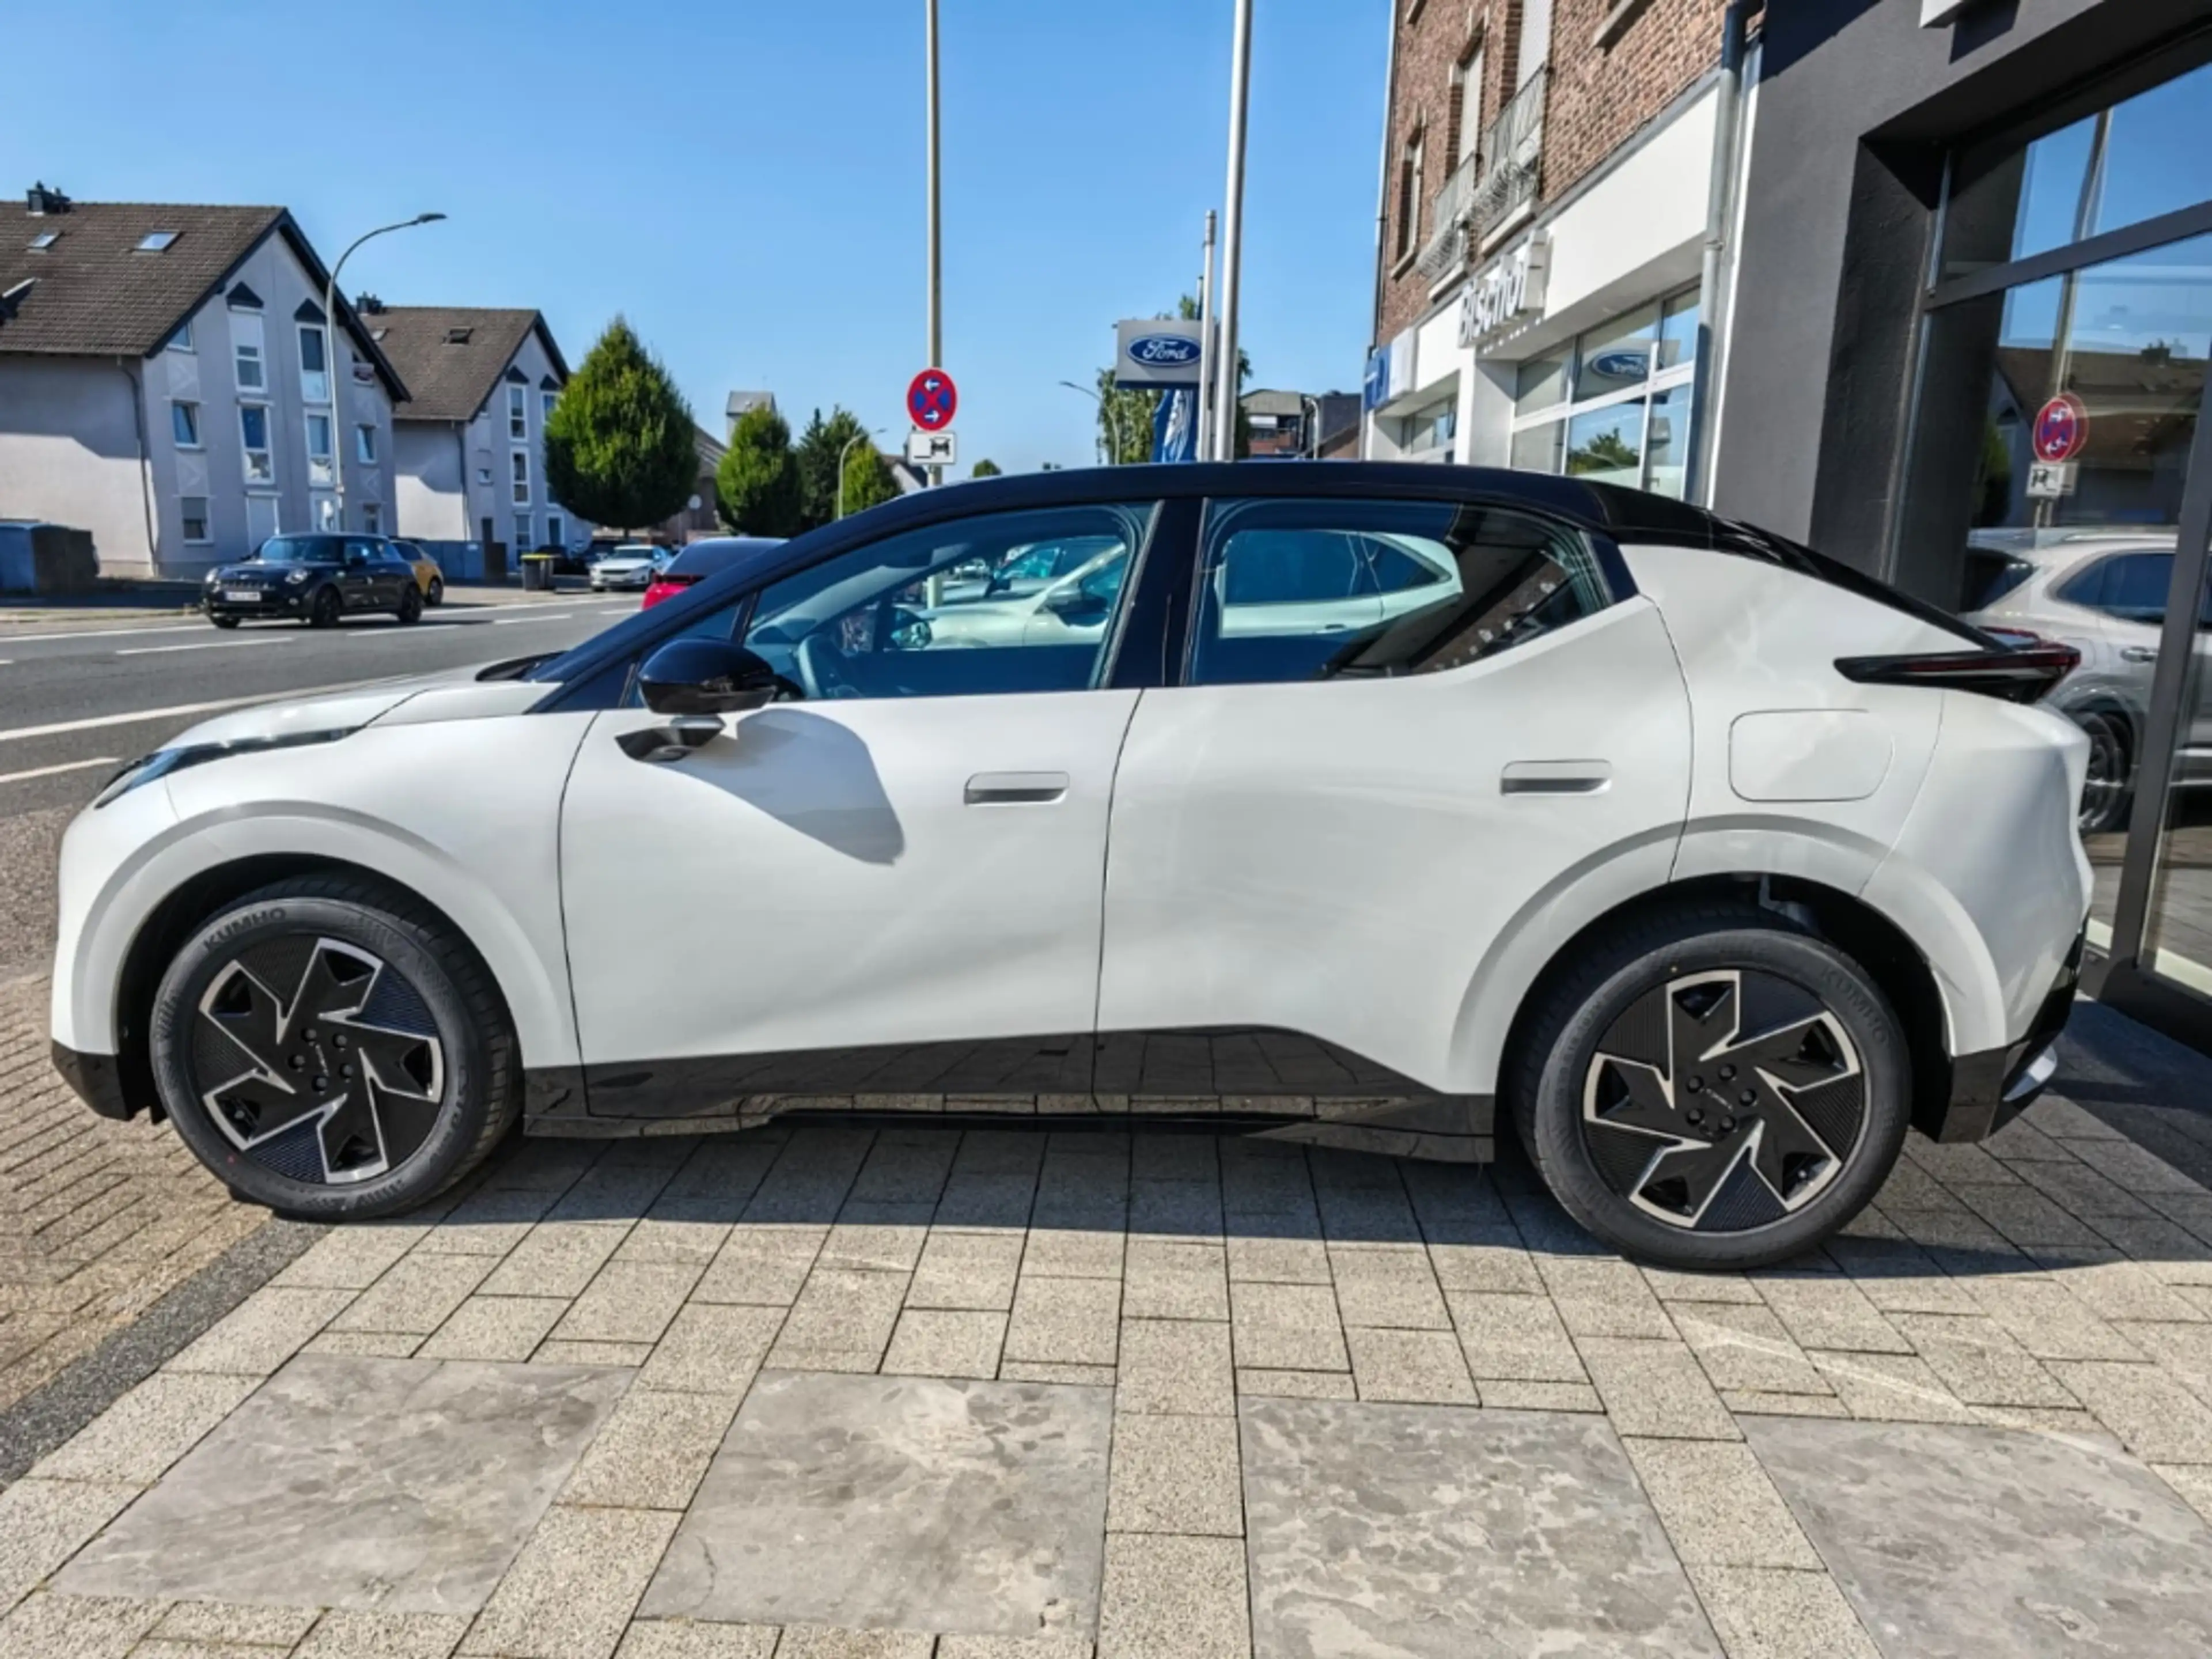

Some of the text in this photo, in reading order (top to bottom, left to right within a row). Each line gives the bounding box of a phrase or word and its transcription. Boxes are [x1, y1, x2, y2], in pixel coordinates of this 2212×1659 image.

[1142, 340, 1189, 360] Ford
[203, 907, 287, 953] KUMHO
[1821, 965, 1888, 1045] KUMHO
